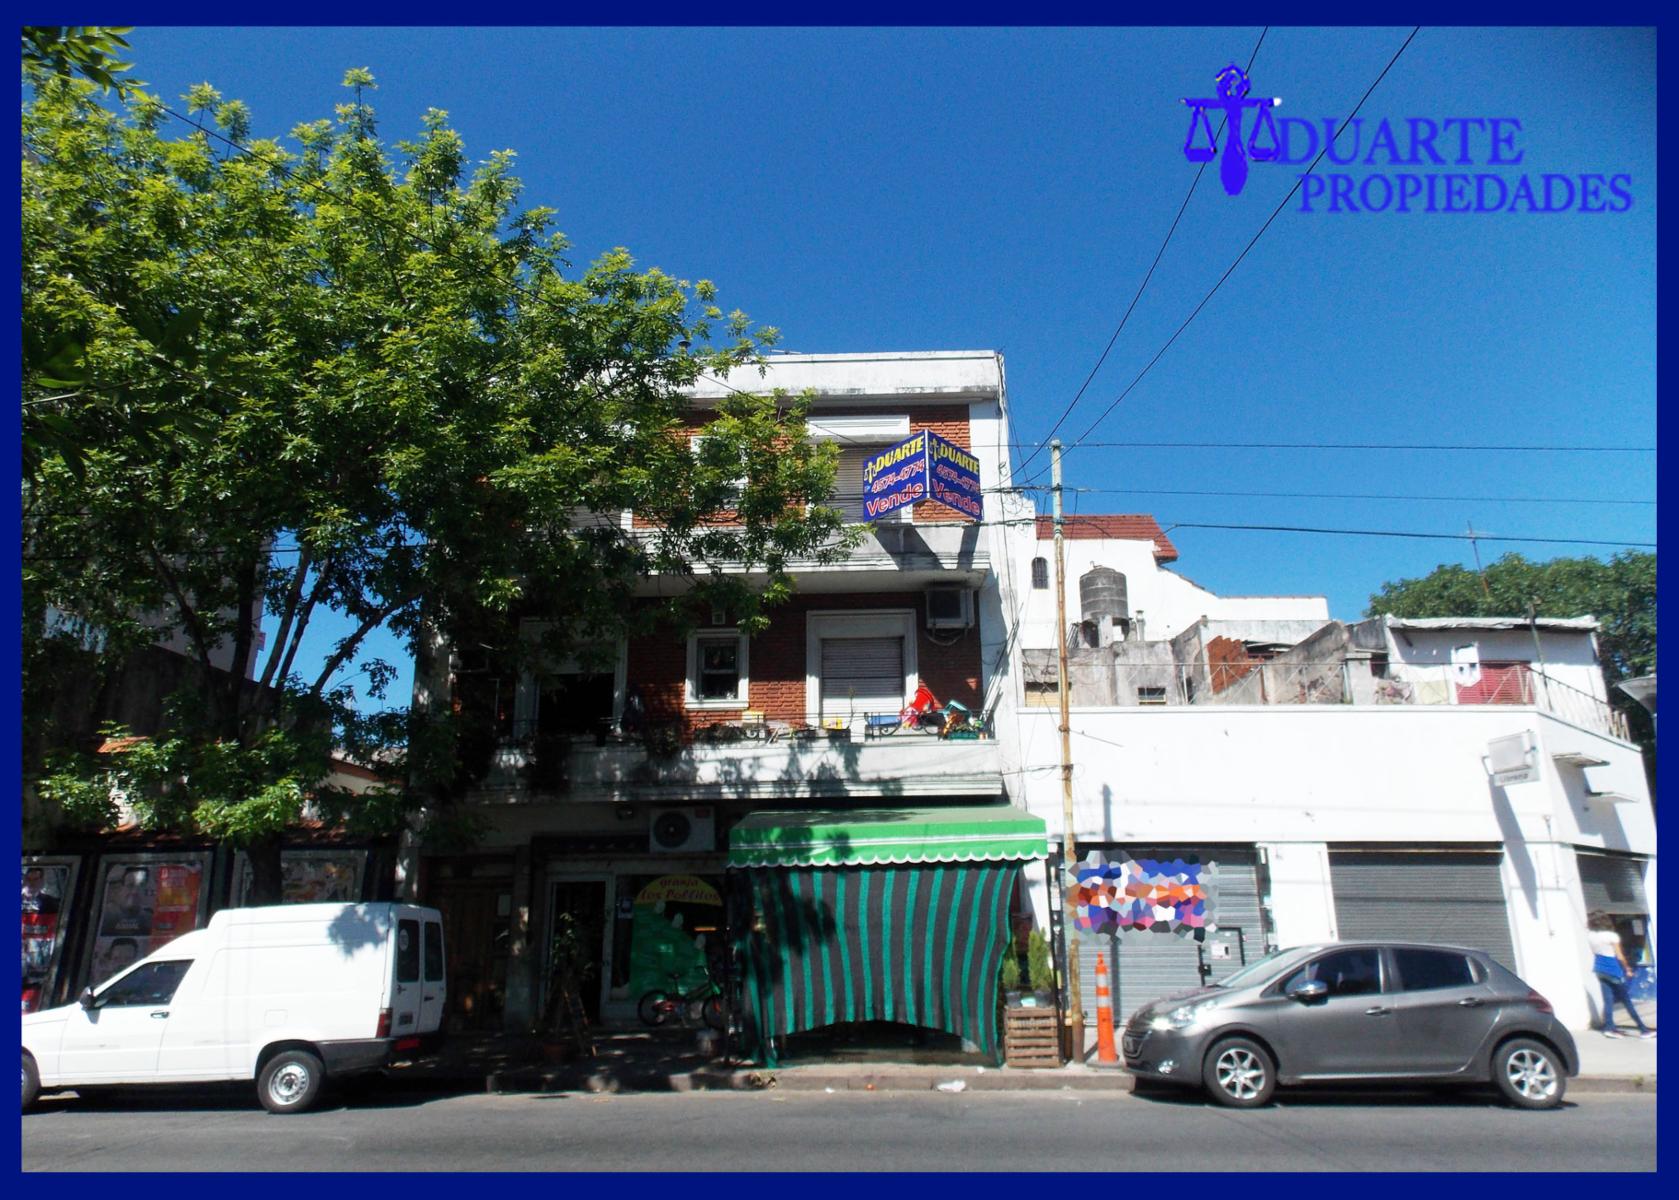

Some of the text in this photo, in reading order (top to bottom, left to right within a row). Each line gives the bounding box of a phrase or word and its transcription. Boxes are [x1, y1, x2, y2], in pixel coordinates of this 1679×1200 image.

[874, 435, 925, 473] DUARTE
[940, 442, 979, 475] DUARTE
[866, 482, 924, 516] Vende
[932, 478, 980, 515] Vende
